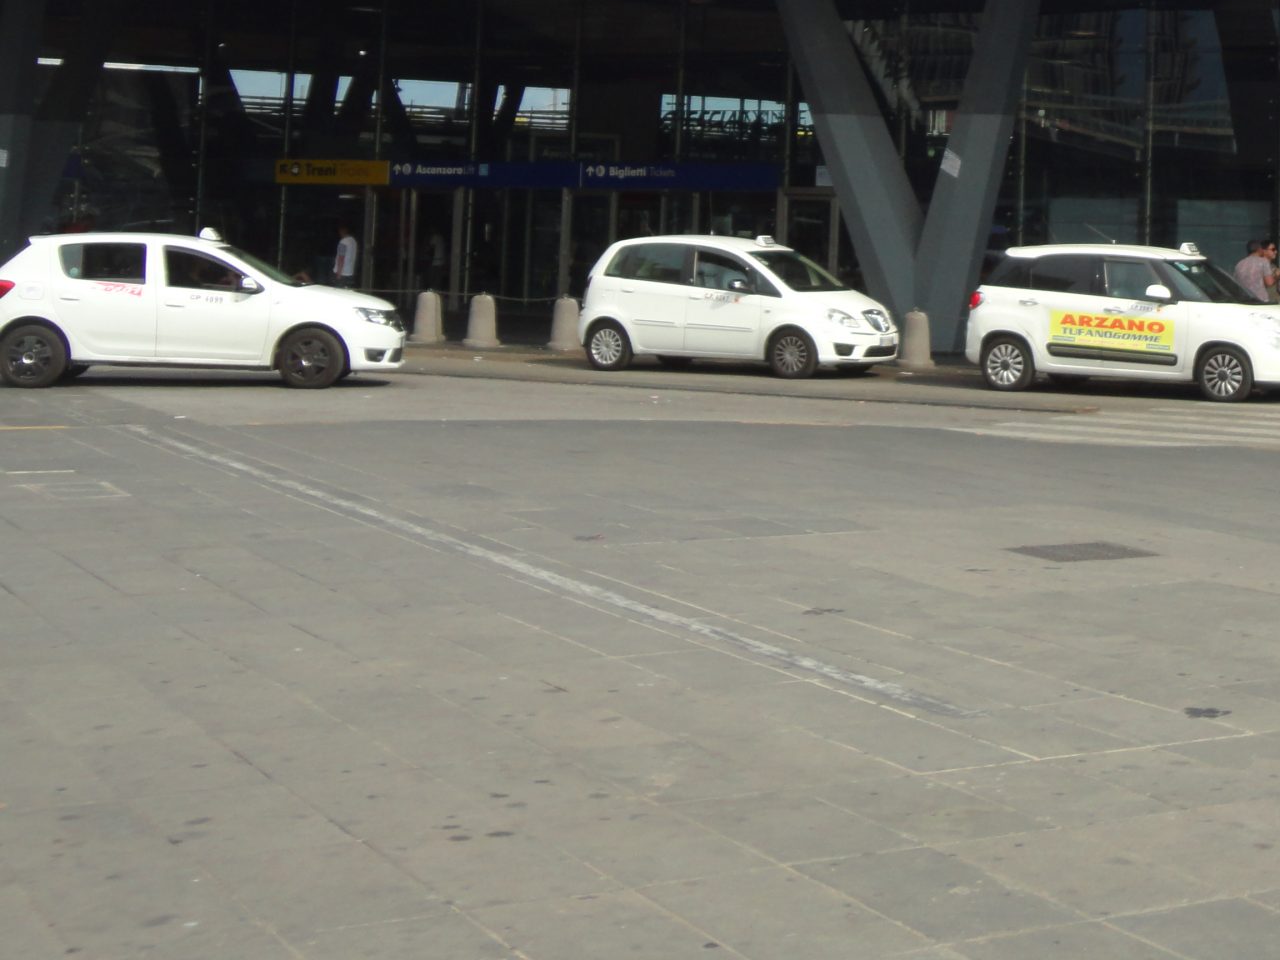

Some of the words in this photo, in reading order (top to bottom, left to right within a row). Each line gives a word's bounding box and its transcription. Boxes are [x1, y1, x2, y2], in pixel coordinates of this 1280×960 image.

[608, 166, 646, 179] Biglietti
[1060, 313, 1165, 334] ARZANO
[1061, 326, 1162, 343] TUFANOGOMME
